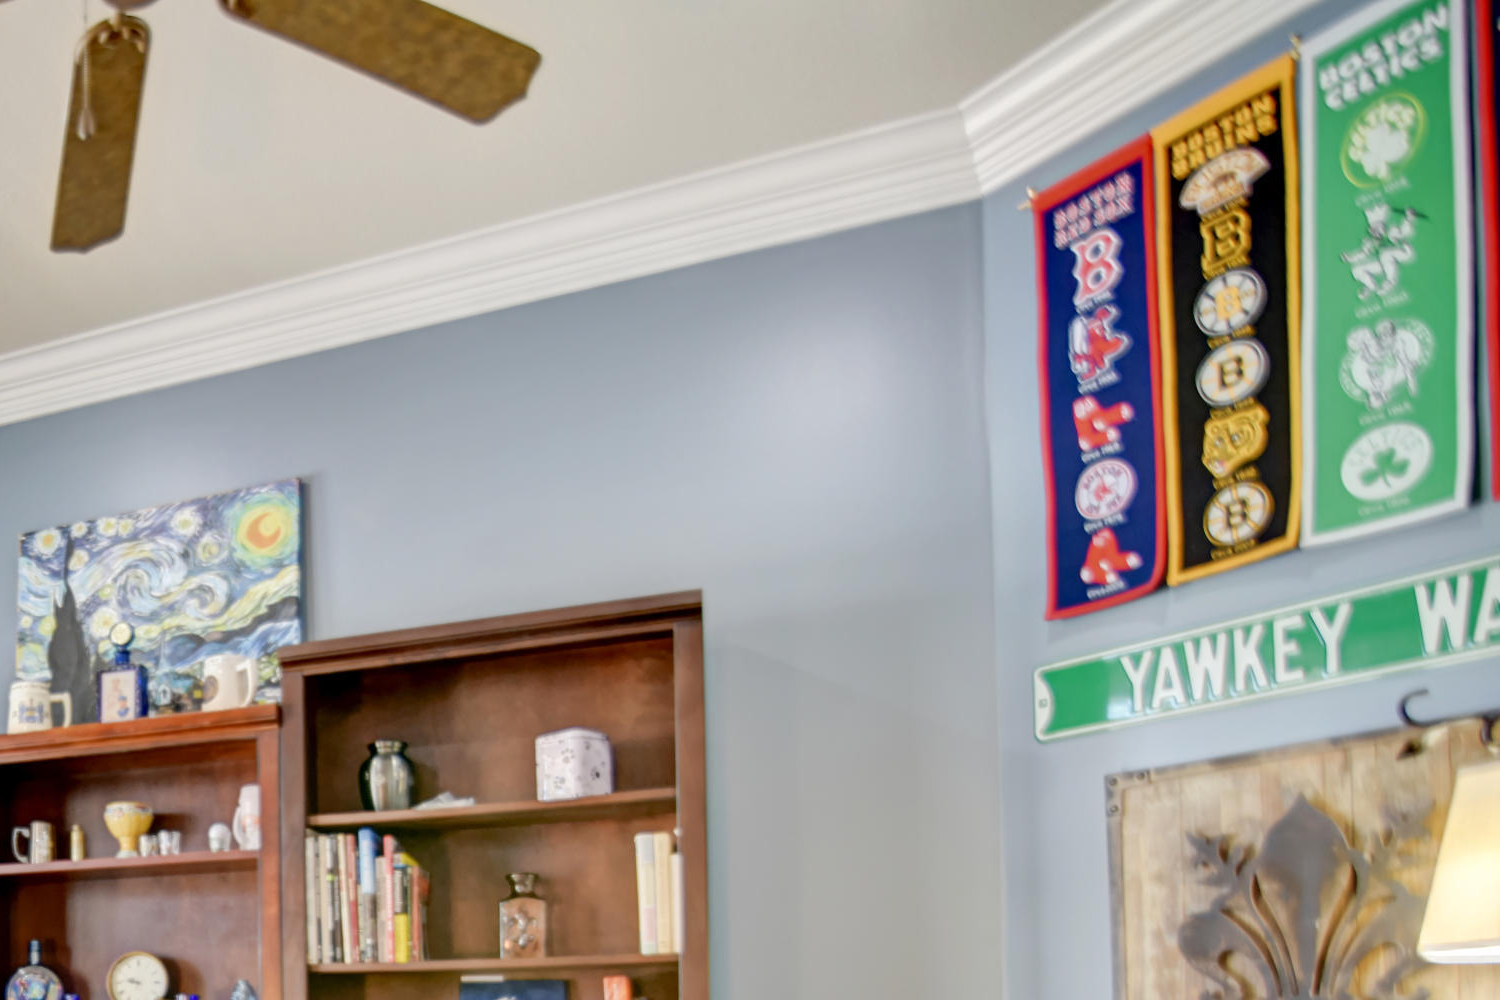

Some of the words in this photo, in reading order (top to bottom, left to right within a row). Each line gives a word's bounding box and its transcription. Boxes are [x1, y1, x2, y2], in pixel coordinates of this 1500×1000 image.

[1319, 2, 1449, 92] BOSTON
[1324, 35, 1443, 111] CELTICS
[1171, 91, 1277, 160] BOSTON
[1171, 114, 1278, 180] BRUINS
[1054, 171, 1134, 230] BOSTON
[1054, 215, 1092, 250] RED
[1093, 194, 1135, 228] SOX
[1071, 229, 1124, 306] B
[1215, 285, 1242, 320] B
[1217, 356, 1245, 392] B
[1223, 498, 1250, 531] B
[1119, 601, 1354, 714] YAWKEY
